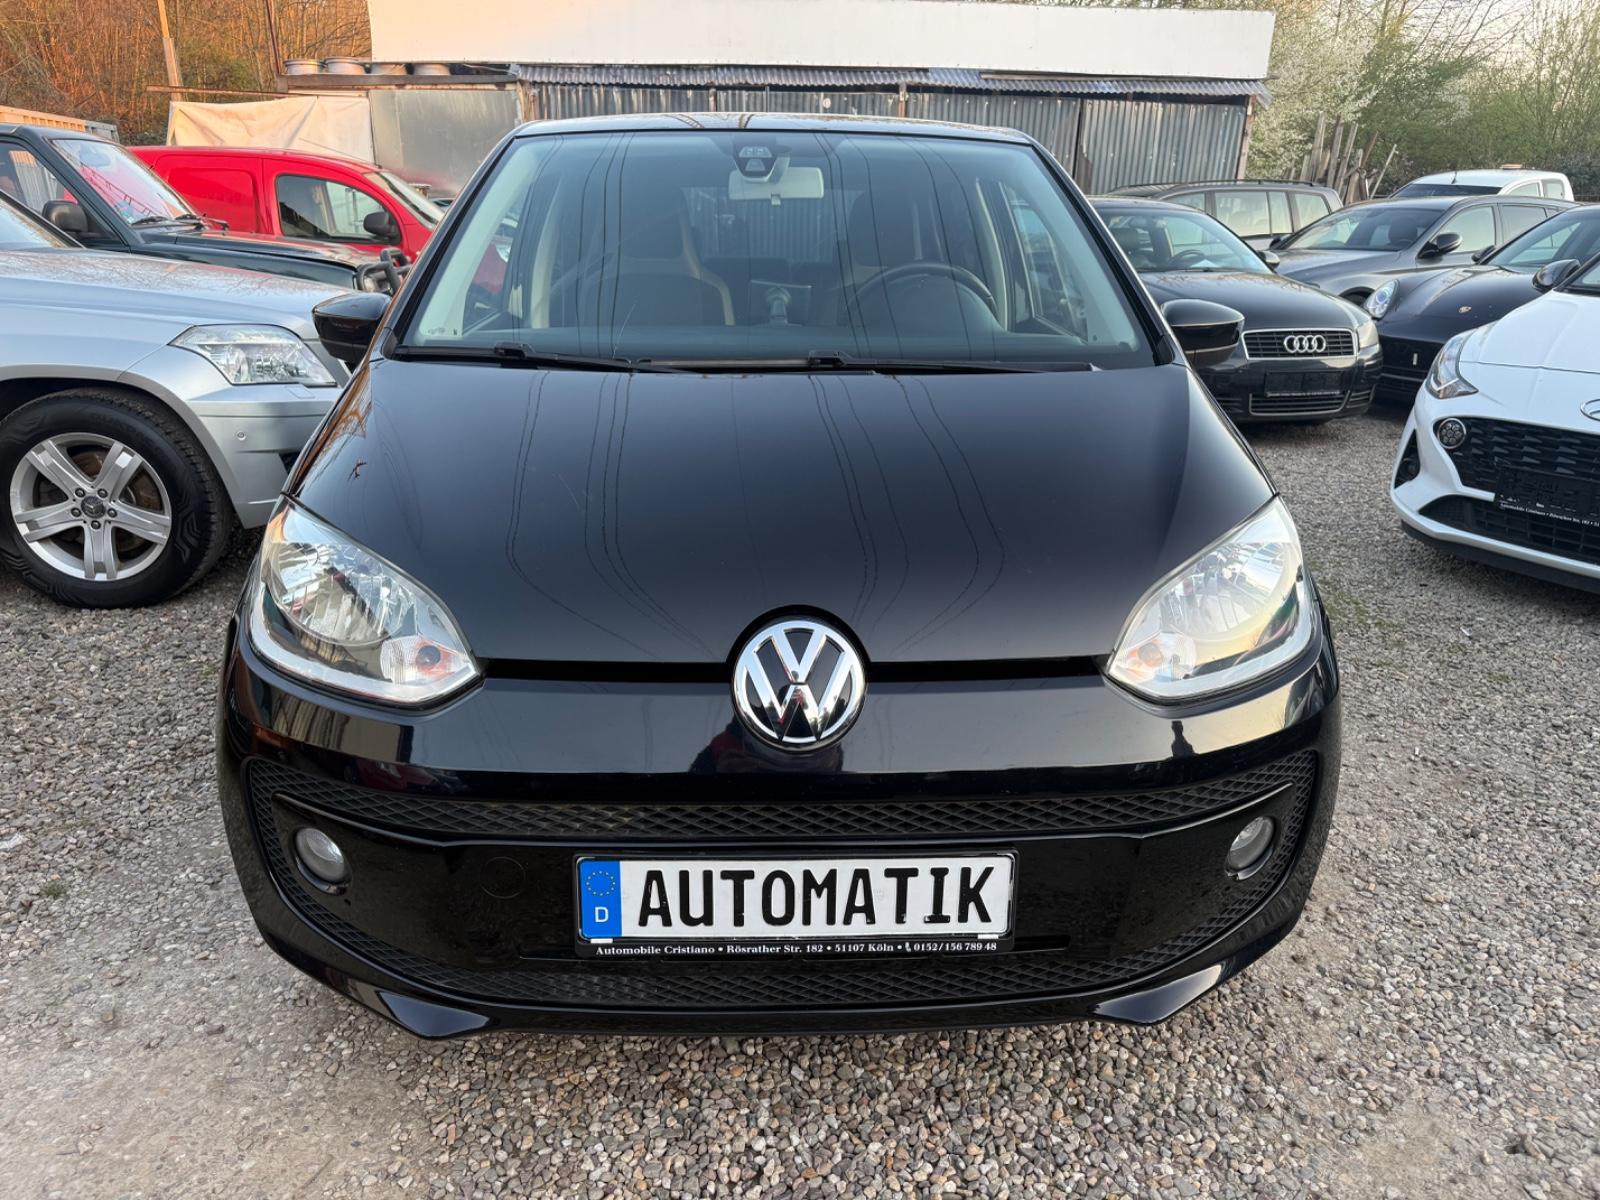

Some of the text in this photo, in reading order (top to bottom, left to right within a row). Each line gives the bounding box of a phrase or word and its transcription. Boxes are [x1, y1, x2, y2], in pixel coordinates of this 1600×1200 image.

[638, 866, 995, 928] AUTOMATIK
[595, 906, 609, 923] D
[596, 946, 661, 955] Automobile
[664, 946, 715, 954] Cristiano
[727, 945, 781, 954] Rösrather
[784, 945, 802, 953] Str.
[806, 944, 823, 953] 182
[835, 944, 865, 953] 51107
[868, 943, 894, 952] Köln
